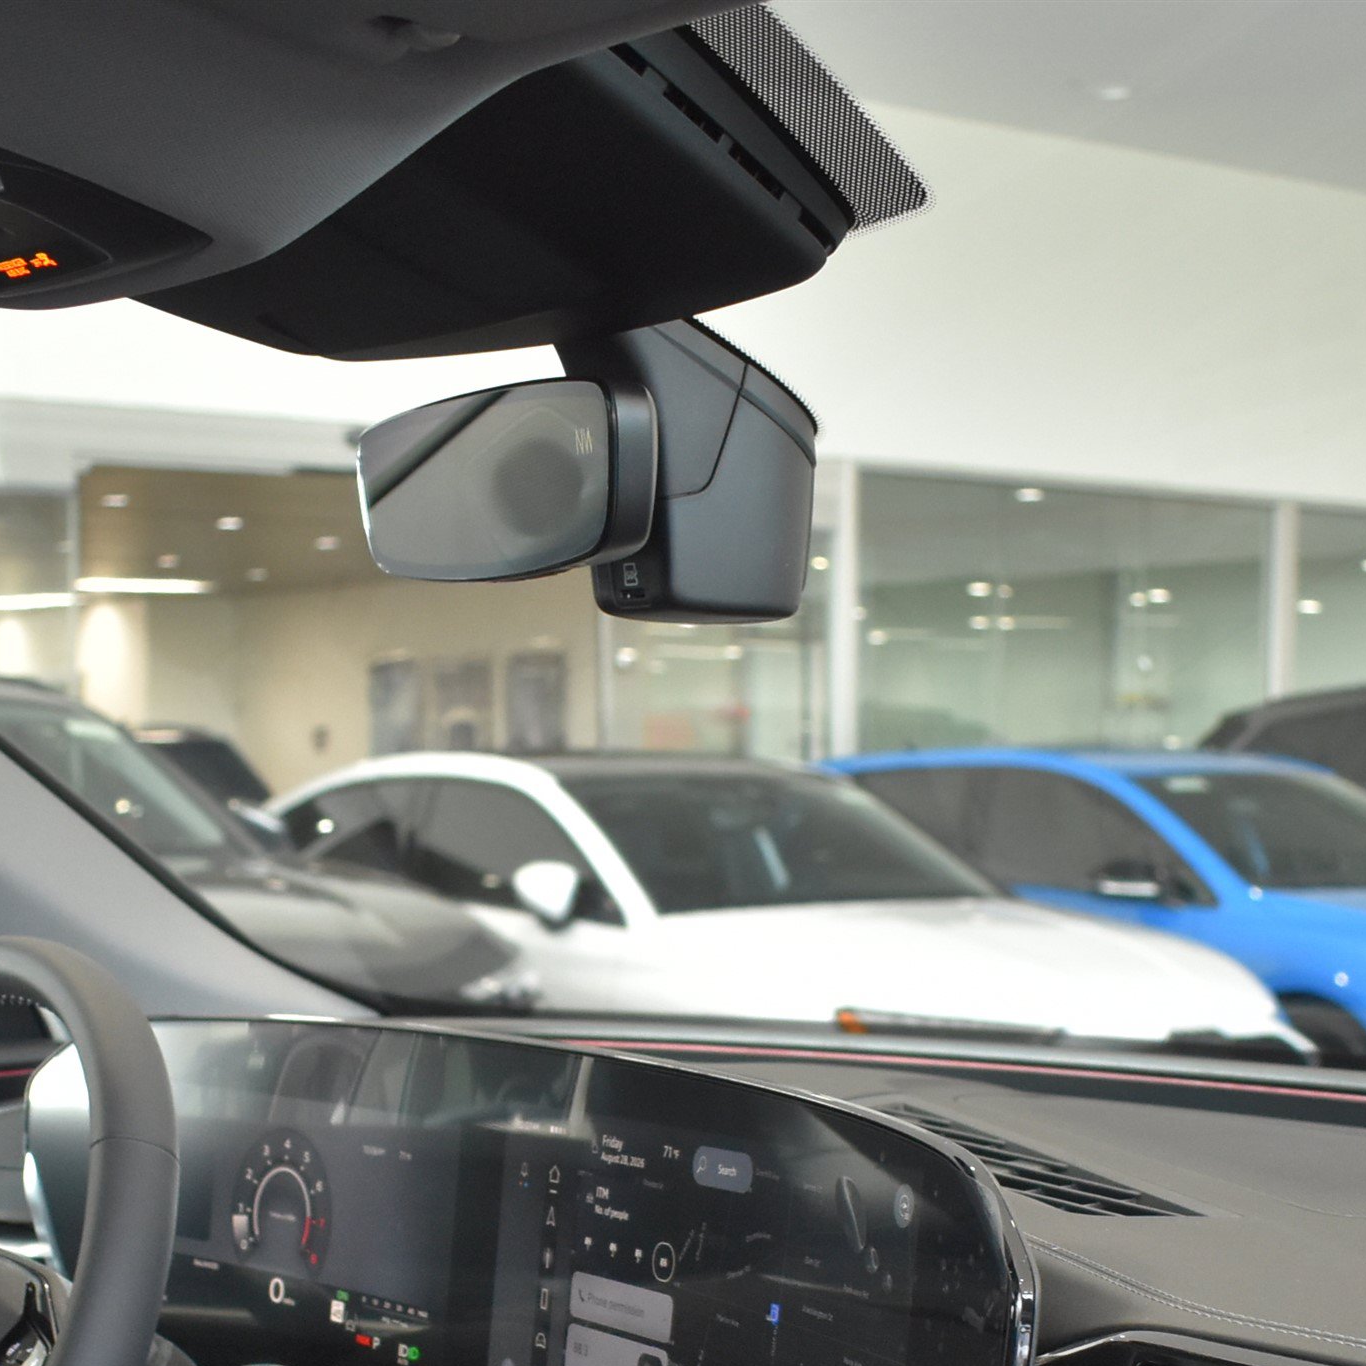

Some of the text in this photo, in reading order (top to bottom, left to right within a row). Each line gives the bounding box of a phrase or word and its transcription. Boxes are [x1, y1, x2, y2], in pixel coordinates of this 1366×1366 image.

[283, 1138, 291, 1149] 4
[245, 1168, 253, 1180] 2
[268, 1277, 285, 1304] 0
[372, 1336, 381, 1350] P
